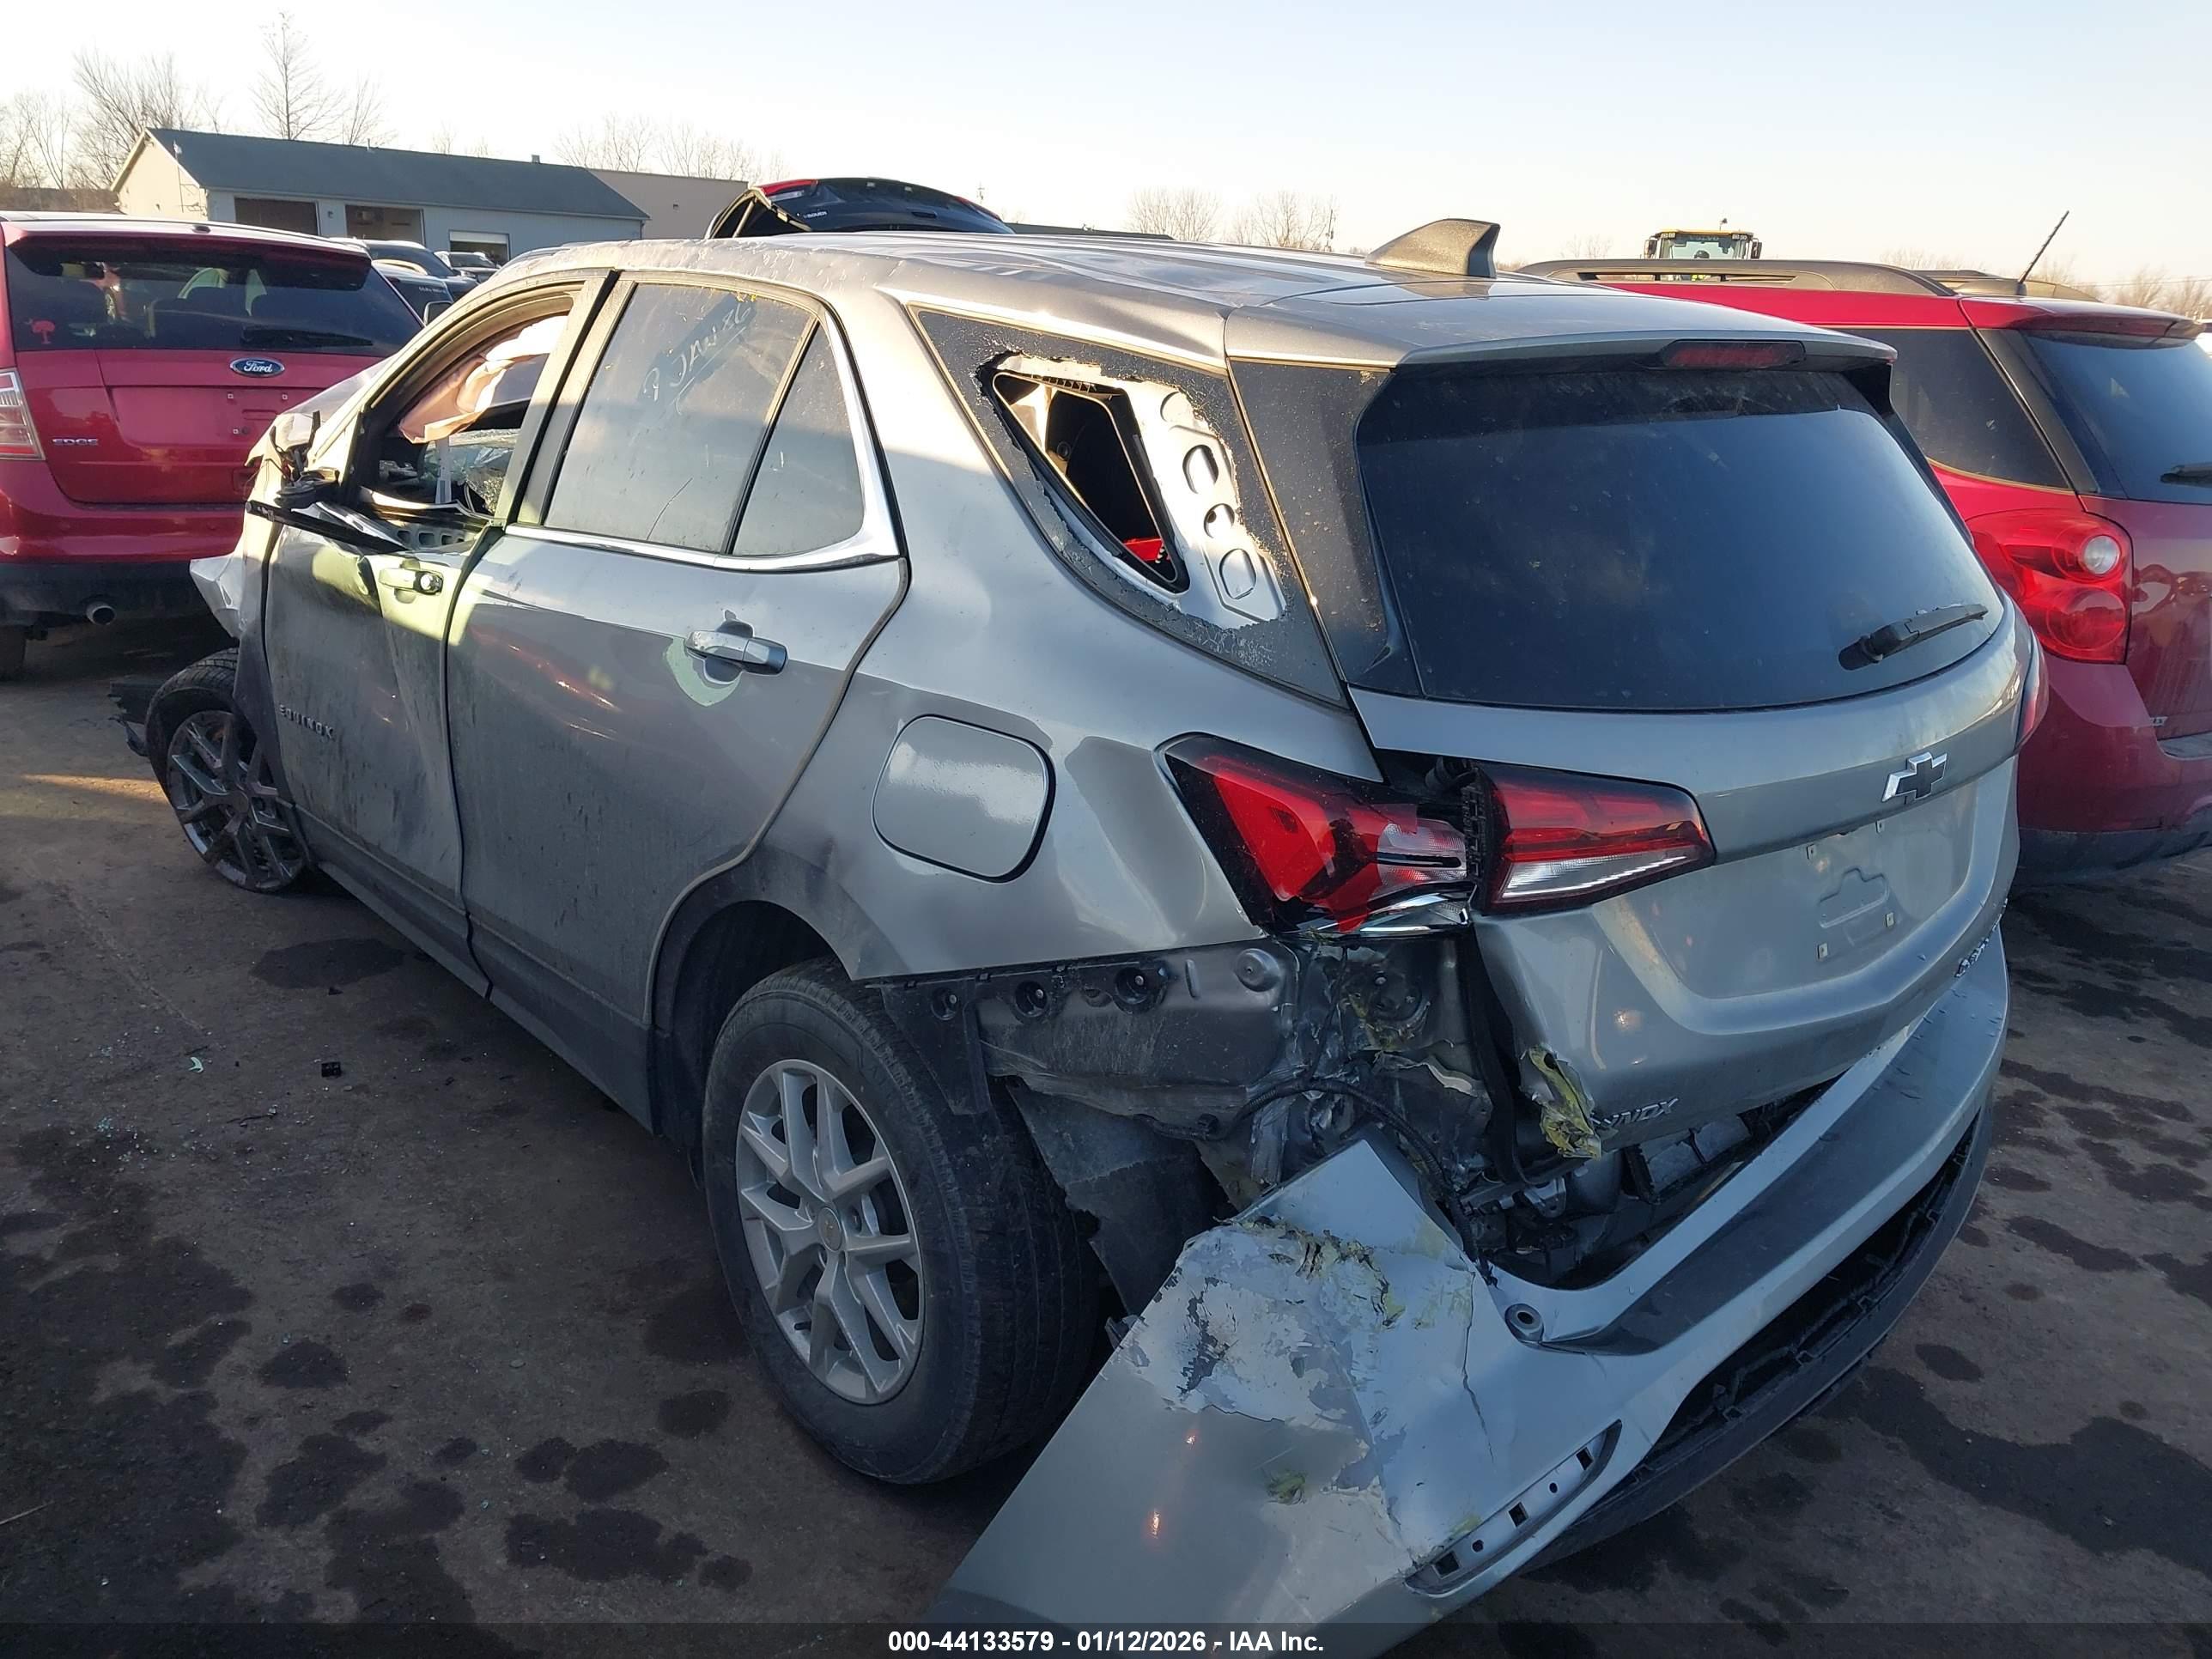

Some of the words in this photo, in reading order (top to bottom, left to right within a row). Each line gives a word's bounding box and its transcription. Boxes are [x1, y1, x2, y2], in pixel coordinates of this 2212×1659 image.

[243, 360, 273, 373] Ford
[52, 438, 98, 447] EDGE
[279, 704, 335, 740] EQUINOX
